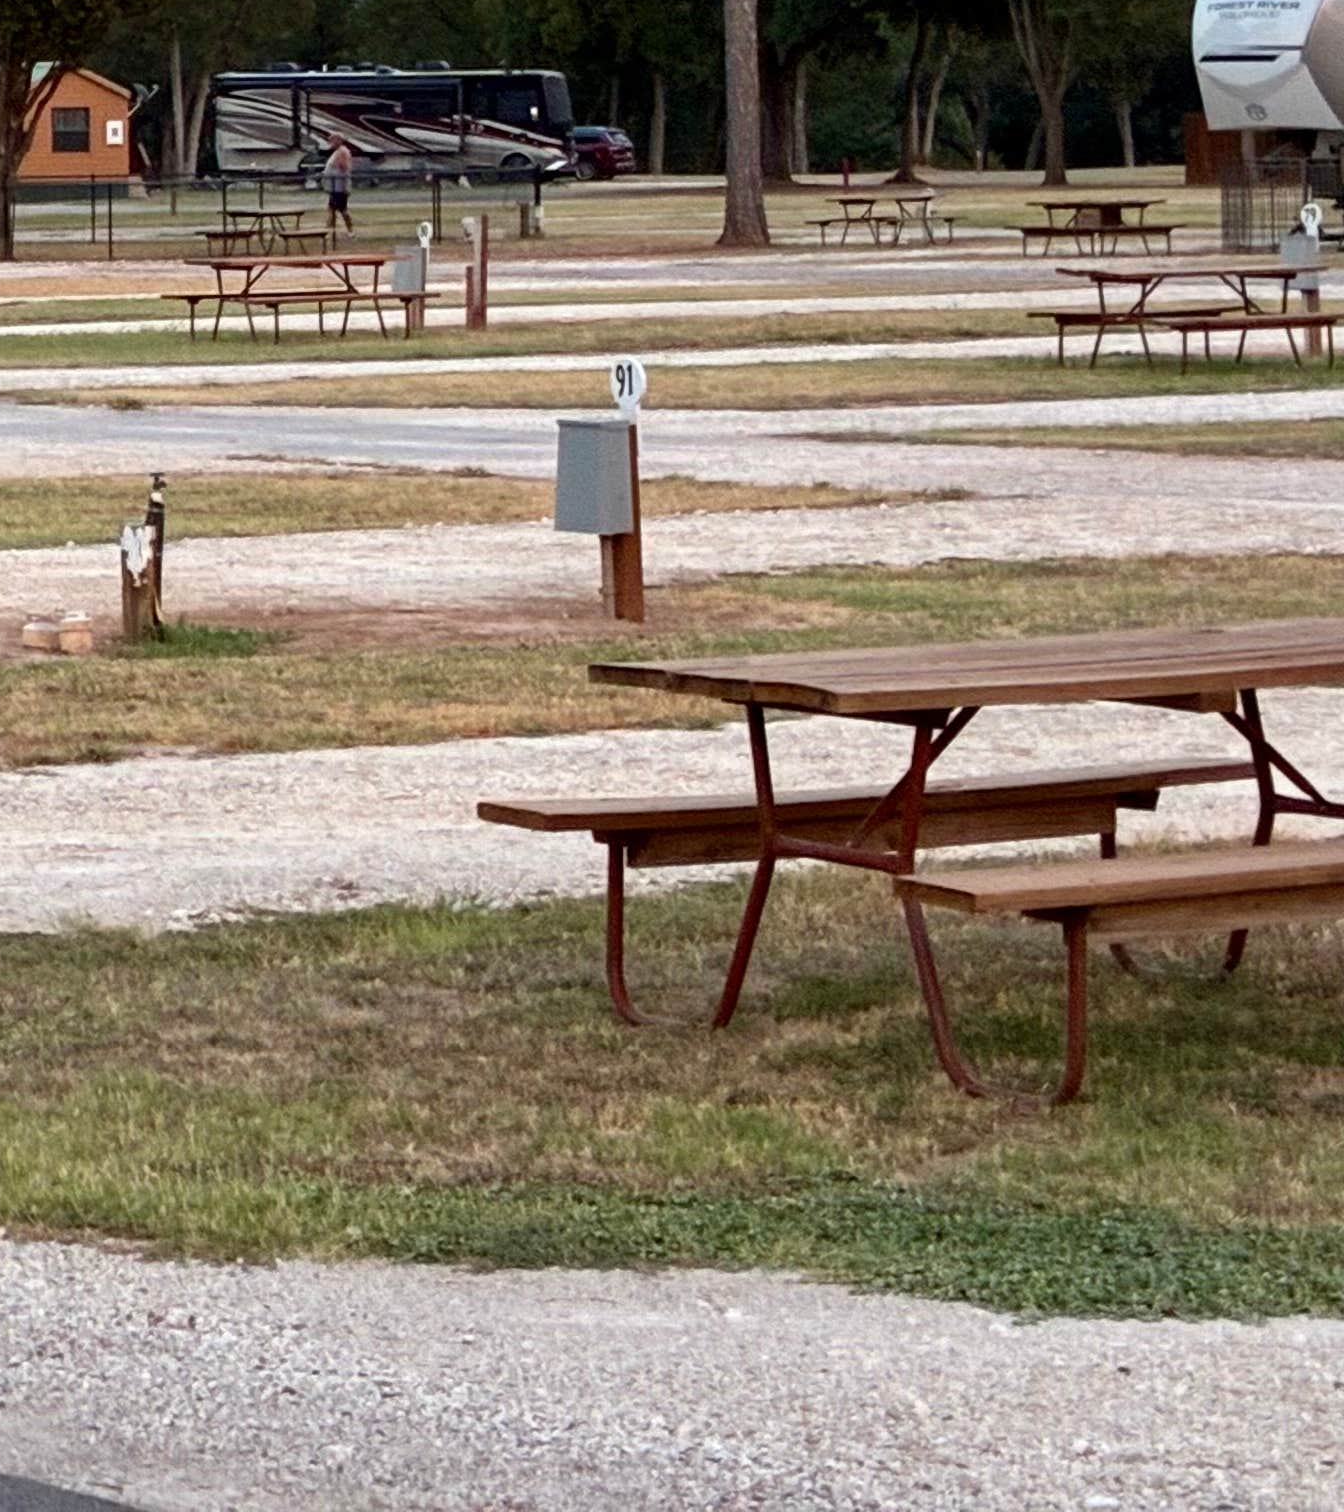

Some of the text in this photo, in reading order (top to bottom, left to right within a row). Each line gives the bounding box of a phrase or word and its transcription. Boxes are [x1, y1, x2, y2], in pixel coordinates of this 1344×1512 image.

[1207, 1, 1301, 11] FOREST RIVER
[615, 364, 634, 398] 91
